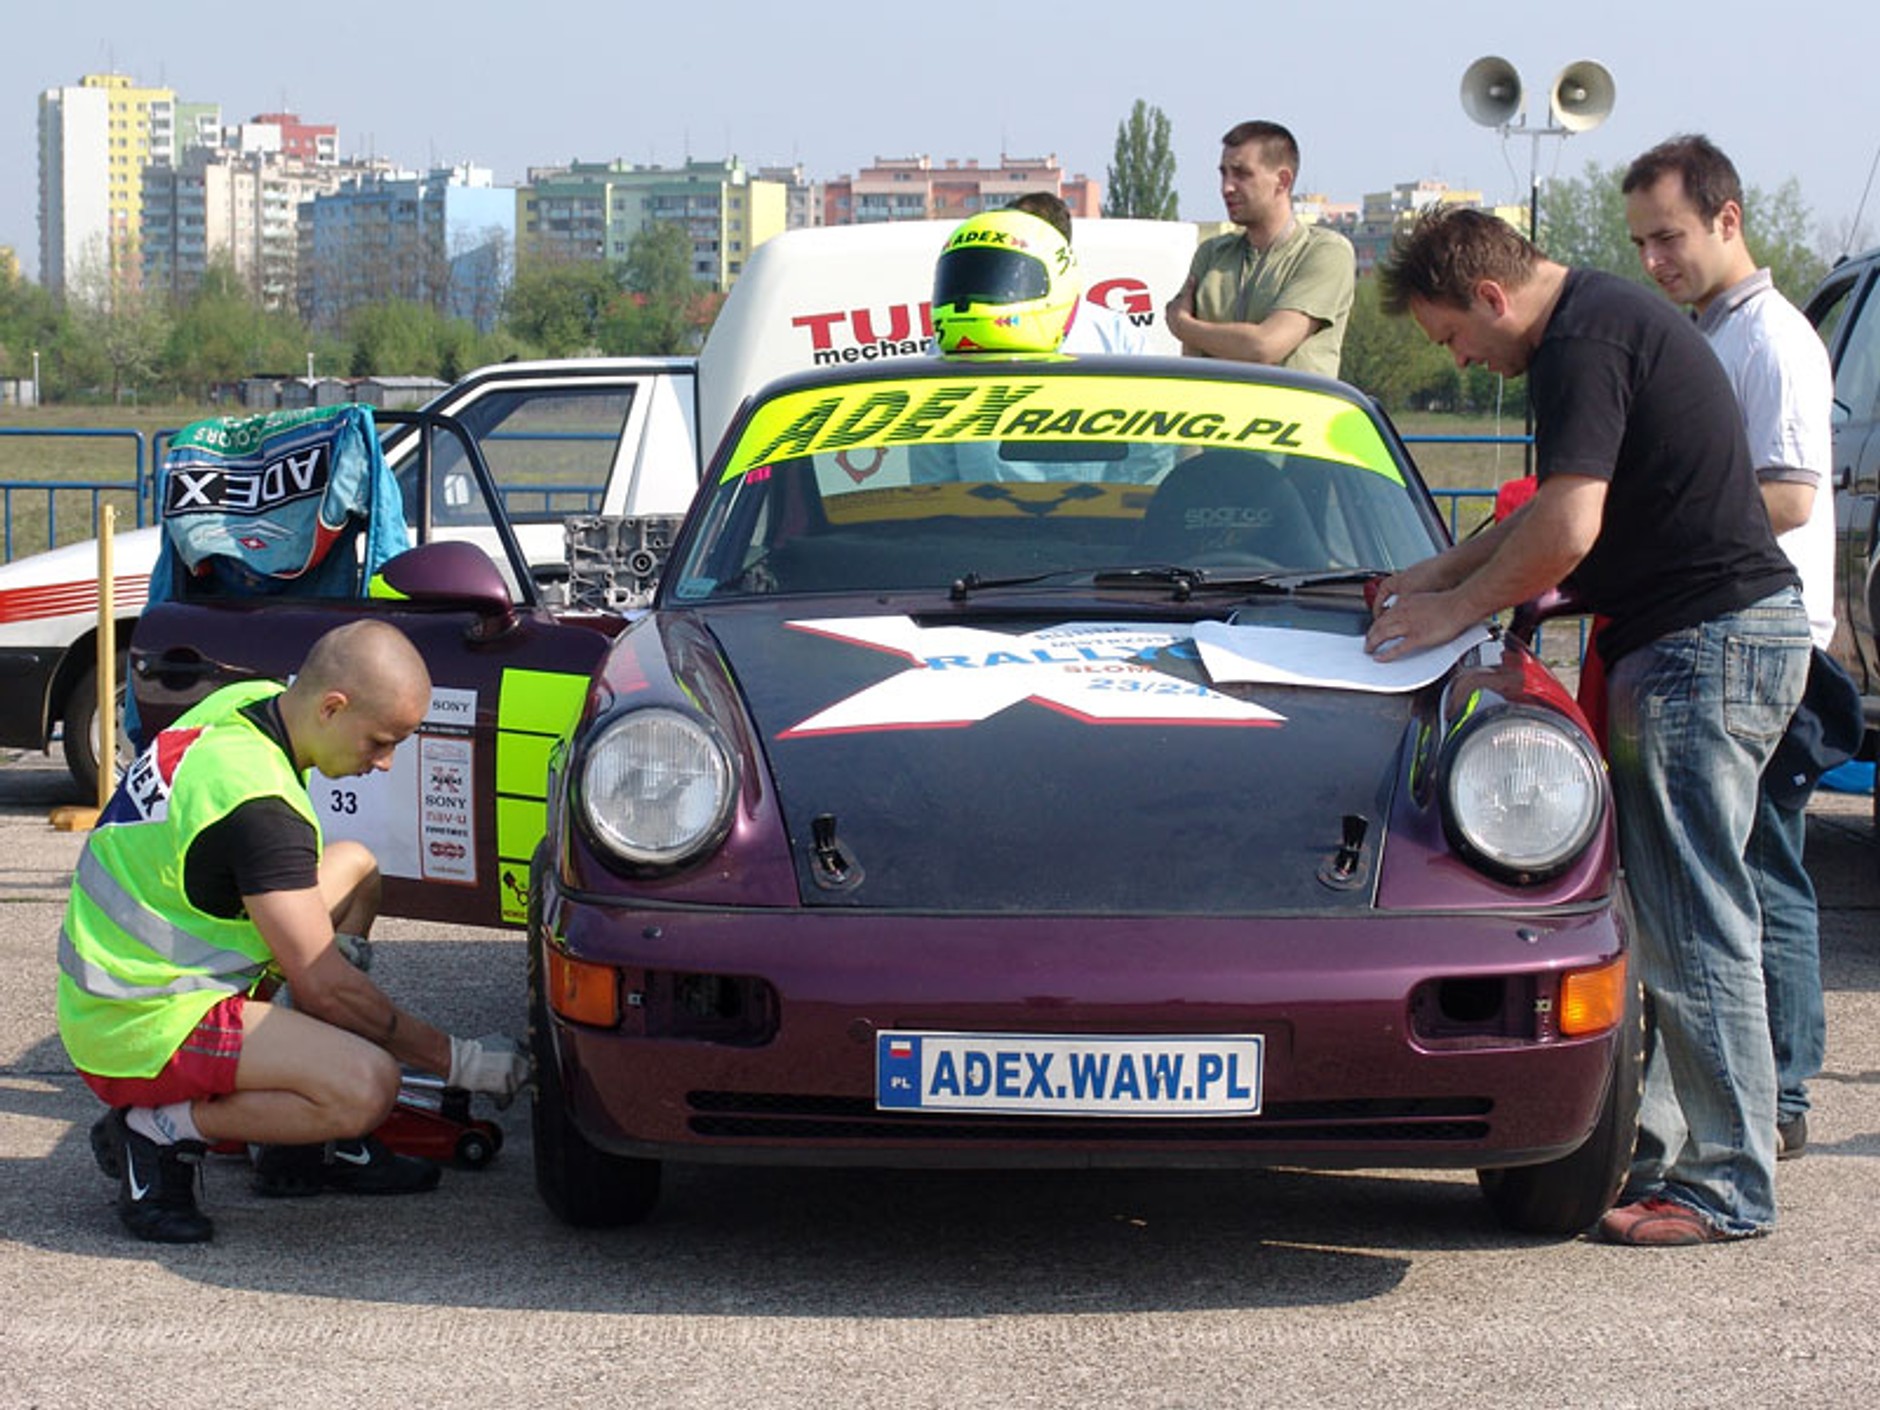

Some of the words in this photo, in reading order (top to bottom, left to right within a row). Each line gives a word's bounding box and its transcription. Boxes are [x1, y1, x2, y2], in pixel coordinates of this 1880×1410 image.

[953, 230, 1009, 245] ADEX
[173, 448, 321, 508] ADEX
[432, 700, 471, 713] SONY
[330, 790, 358, 814] 33
[425, 795, 467, 809] SONY
[929, 1049, 1251, 1100] ADEX.WAW.PL
[890, 1076, 912, 1089] PL
